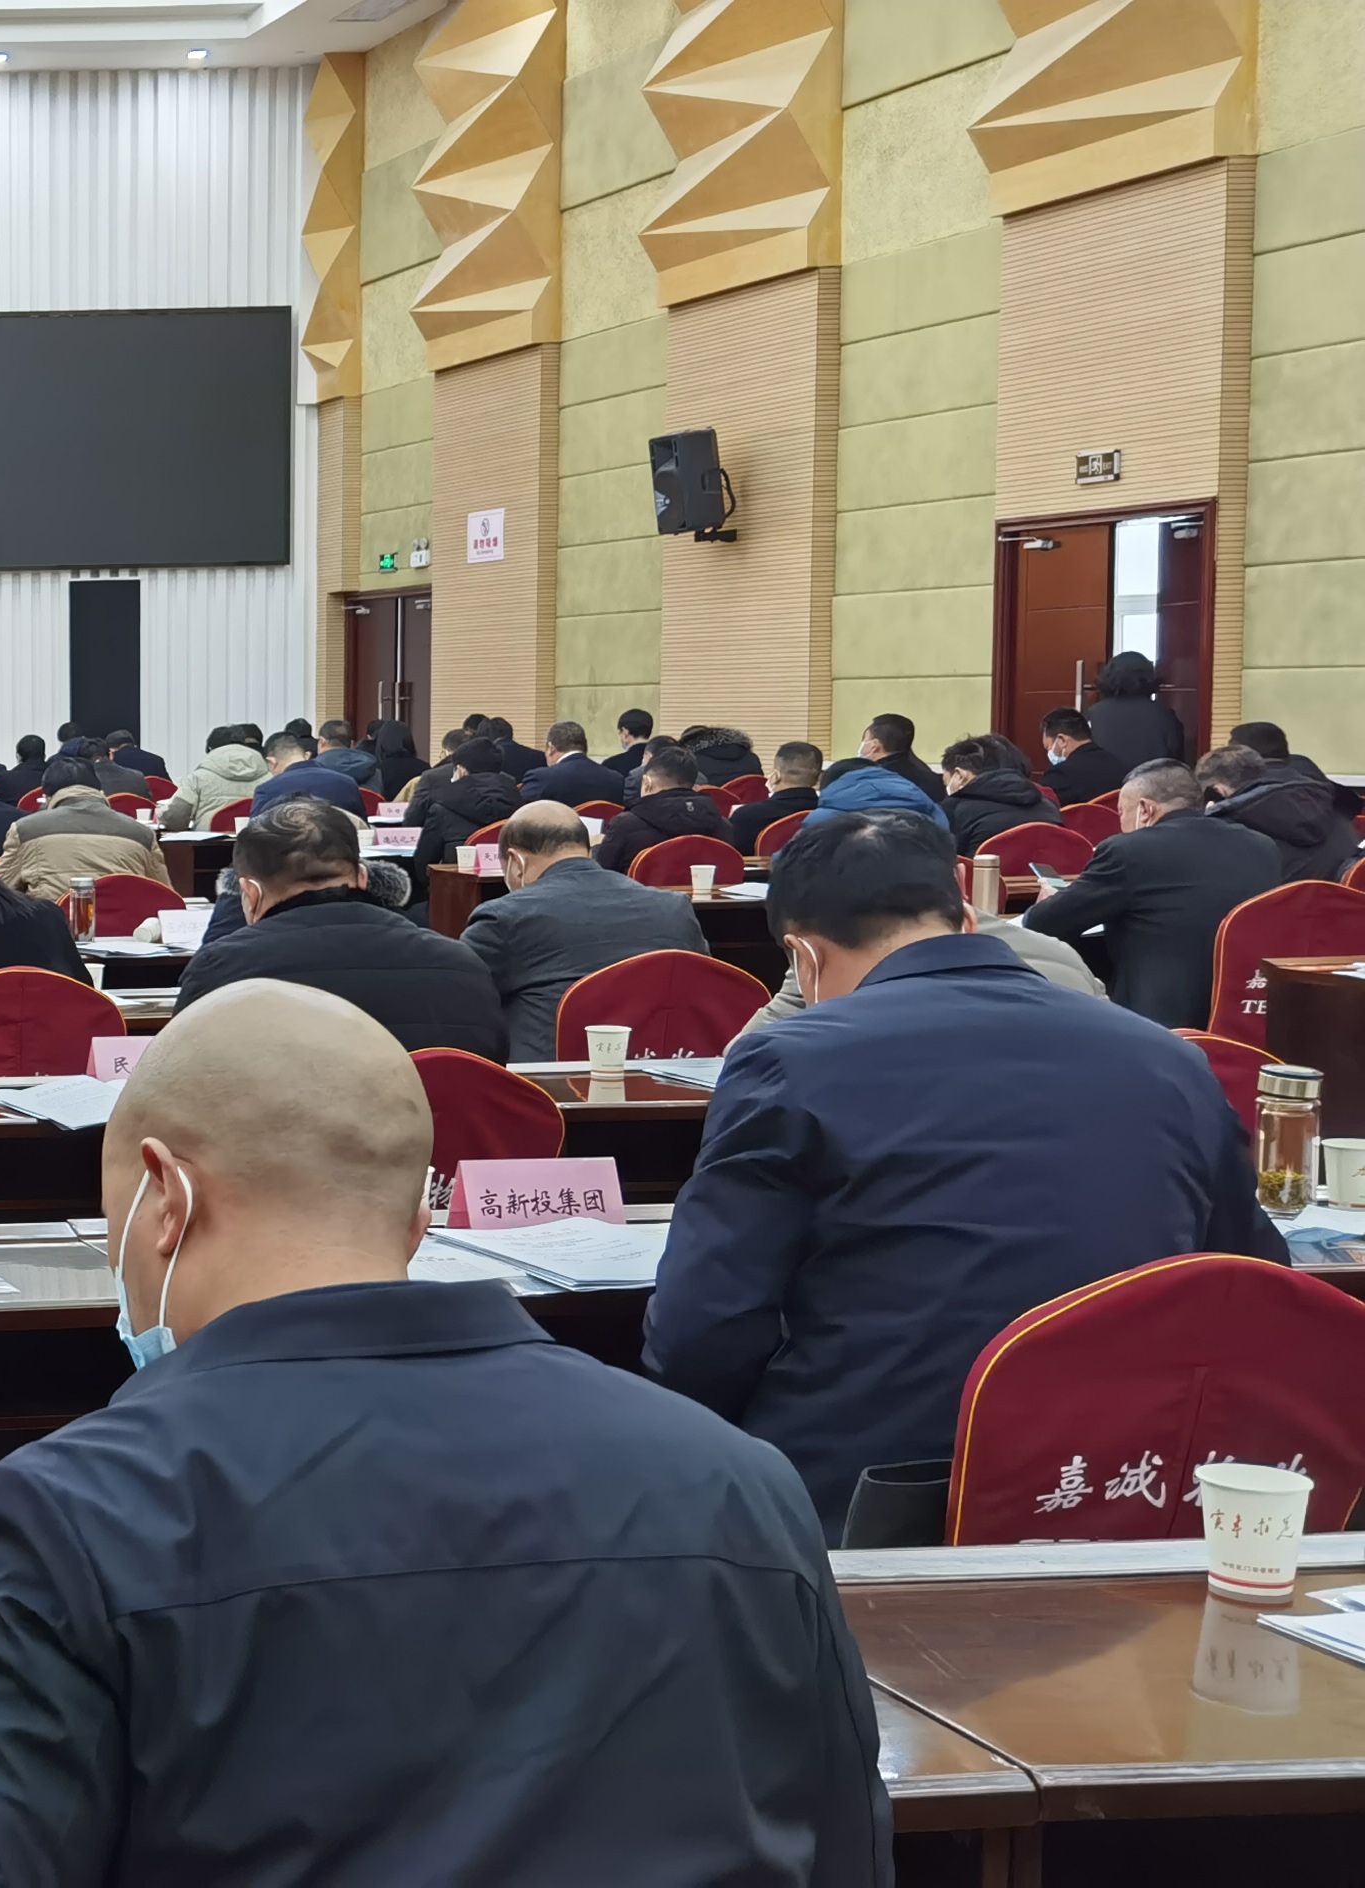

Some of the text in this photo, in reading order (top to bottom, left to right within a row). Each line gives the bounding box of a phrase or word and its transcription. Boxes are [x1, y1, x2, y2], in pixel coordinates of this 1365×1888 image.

[114, 1057, 135, 1074] 民
[479, 1188, 606, 1219] 高新投集团
